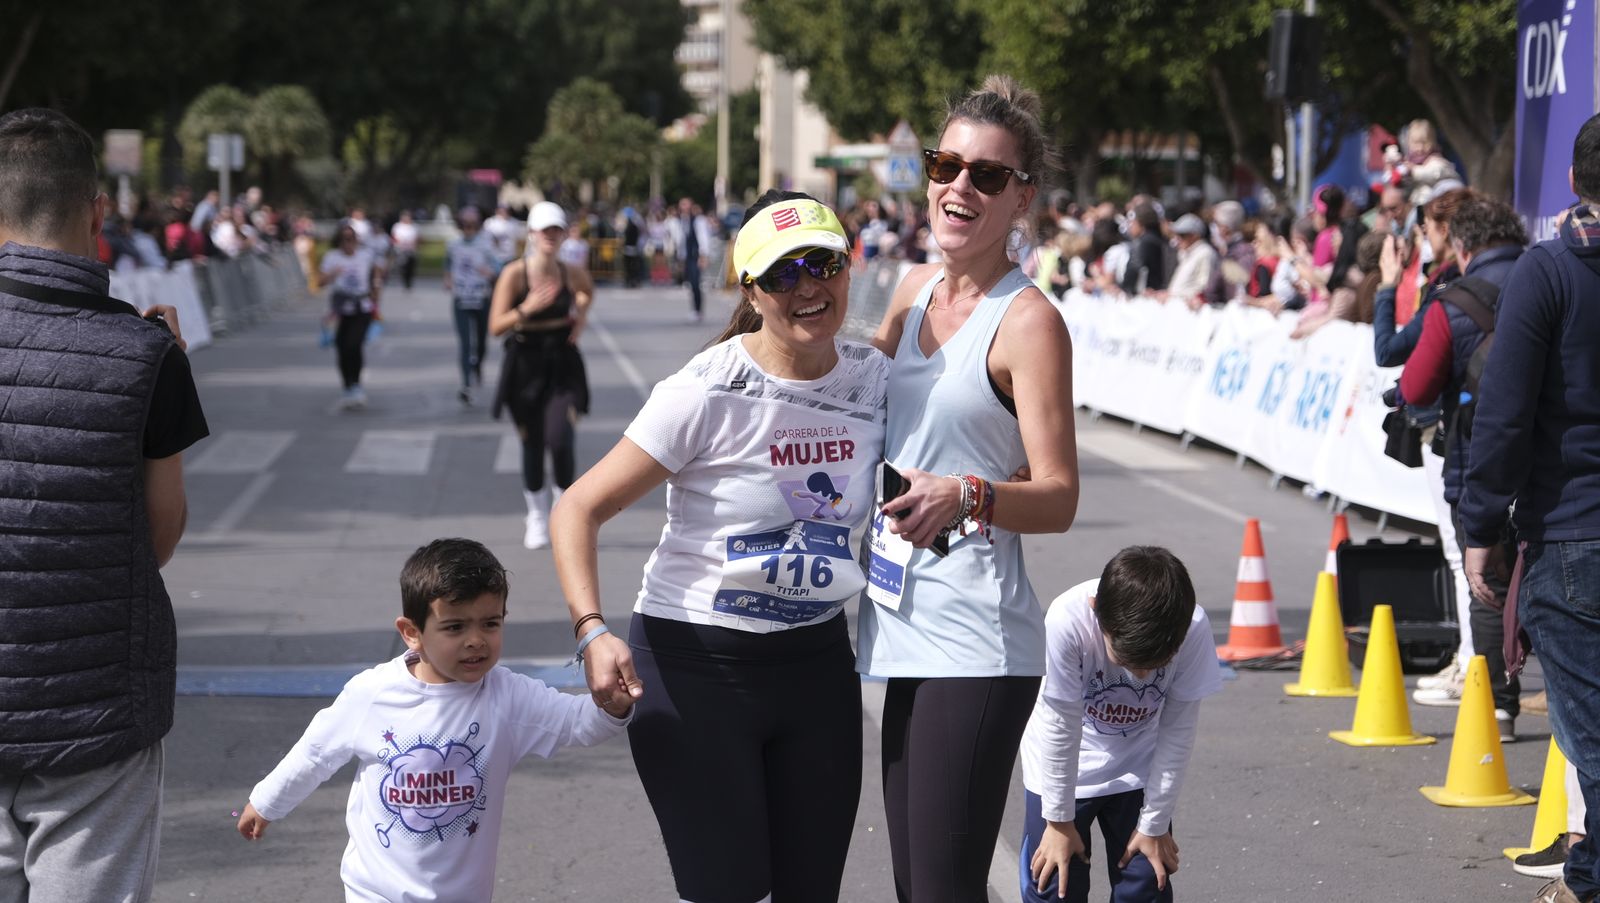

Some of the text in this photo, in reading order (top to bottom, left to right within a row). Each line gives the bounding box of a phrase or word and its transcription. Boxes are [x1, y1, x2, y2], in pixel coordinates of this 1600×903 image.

[1523, 19, 1567, 100] CDX
[774, 425, 849, 440] CARRERA DE LA
[769, 439, 855, 467] MUJER
[746, 543, 780, 553] MUJER
[761, 555, 834, 588] 116
[776, 585, 810, 597] TITAPI
[1087, 705, 1158, 723] RUNN
[1106, 703, 1148, 716] MINI
[406, 770, 455, 789] MINI
[388, 785, 475, 805] RUNNER
